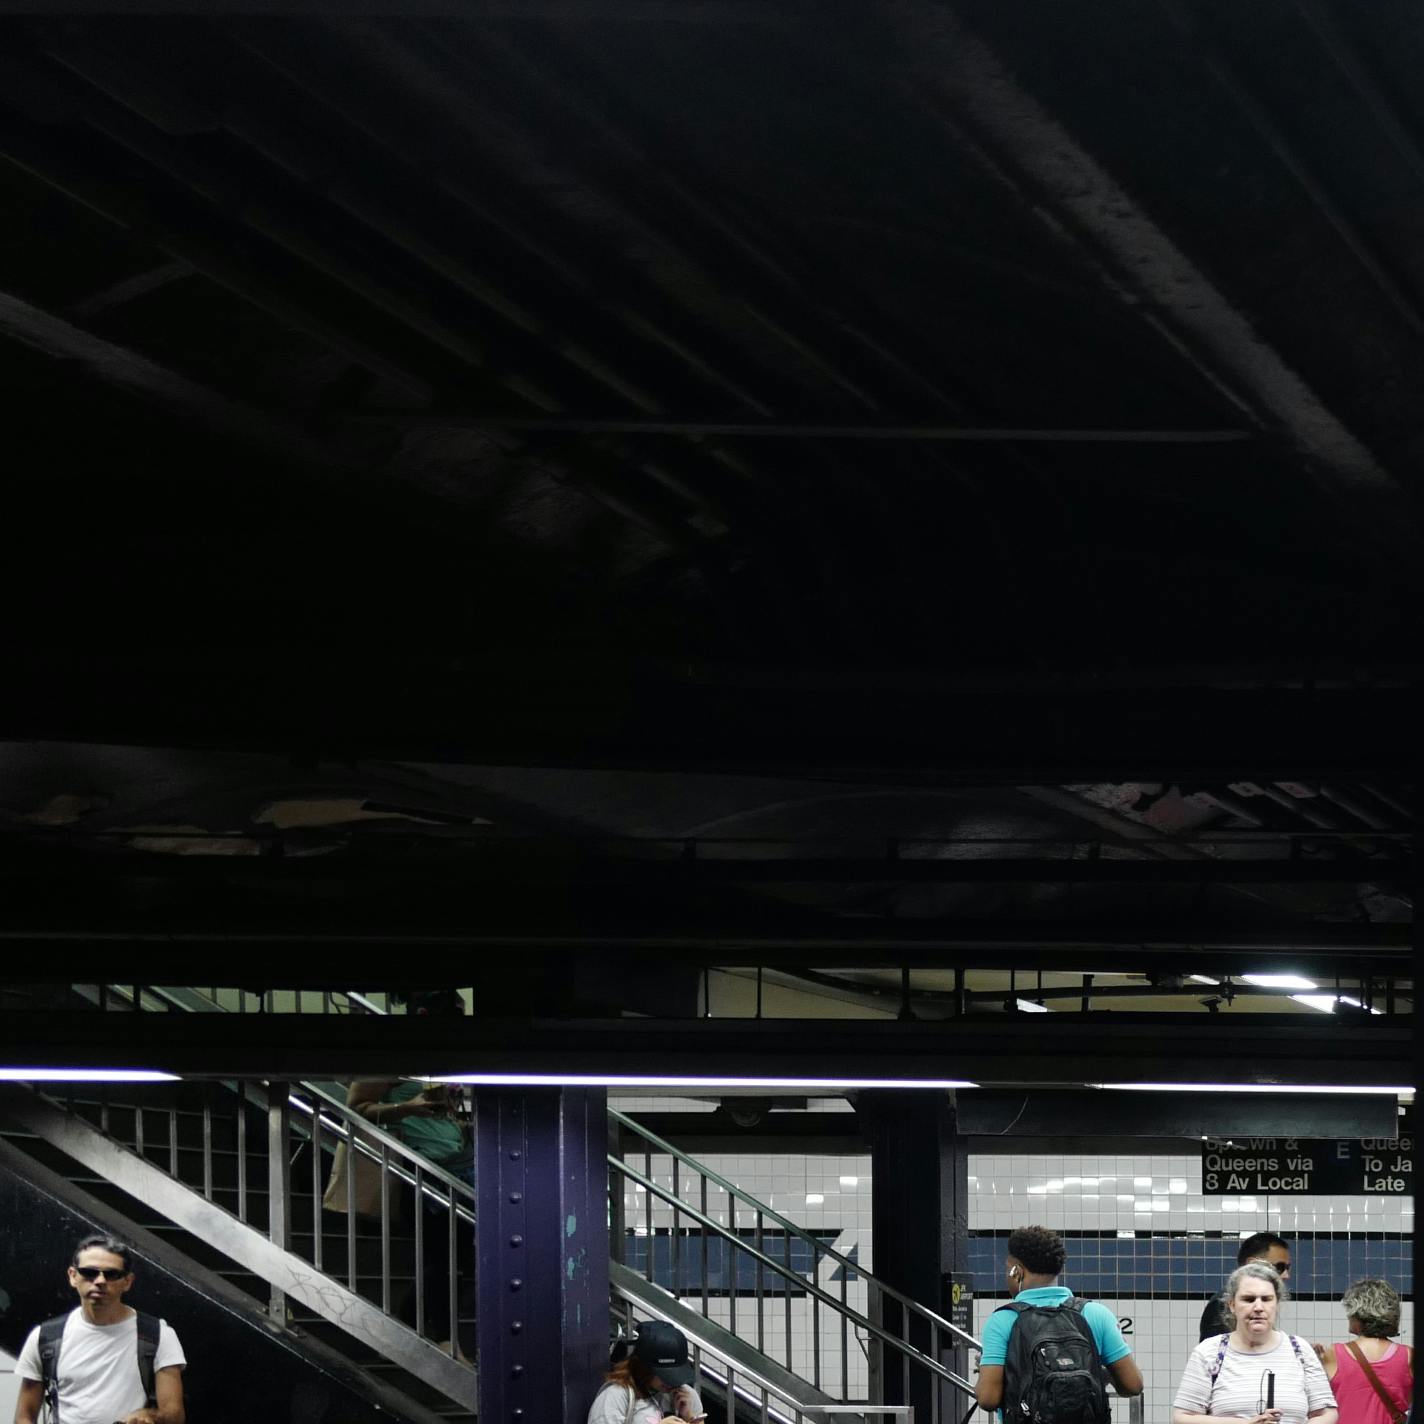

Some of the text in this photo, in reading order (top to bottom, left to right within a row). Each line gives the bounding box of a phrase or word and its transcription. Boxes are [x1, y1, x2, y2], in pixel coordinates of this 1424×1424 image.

[1206, 1138, 1277, 1153] Upwn
[1337, 1142, 1350, 1159] E
[1360, 1138, 1414, 1151] Quee
[1205, 1155, 1314, 1171] Queens via
[1361, 1155, 1383, 1172] To
[1205, 1173, 1309, 1190] 8 Av Local
[1363, 1174, 1405, 1192] Late
[1119, 1318, 1133, 1335] 2
